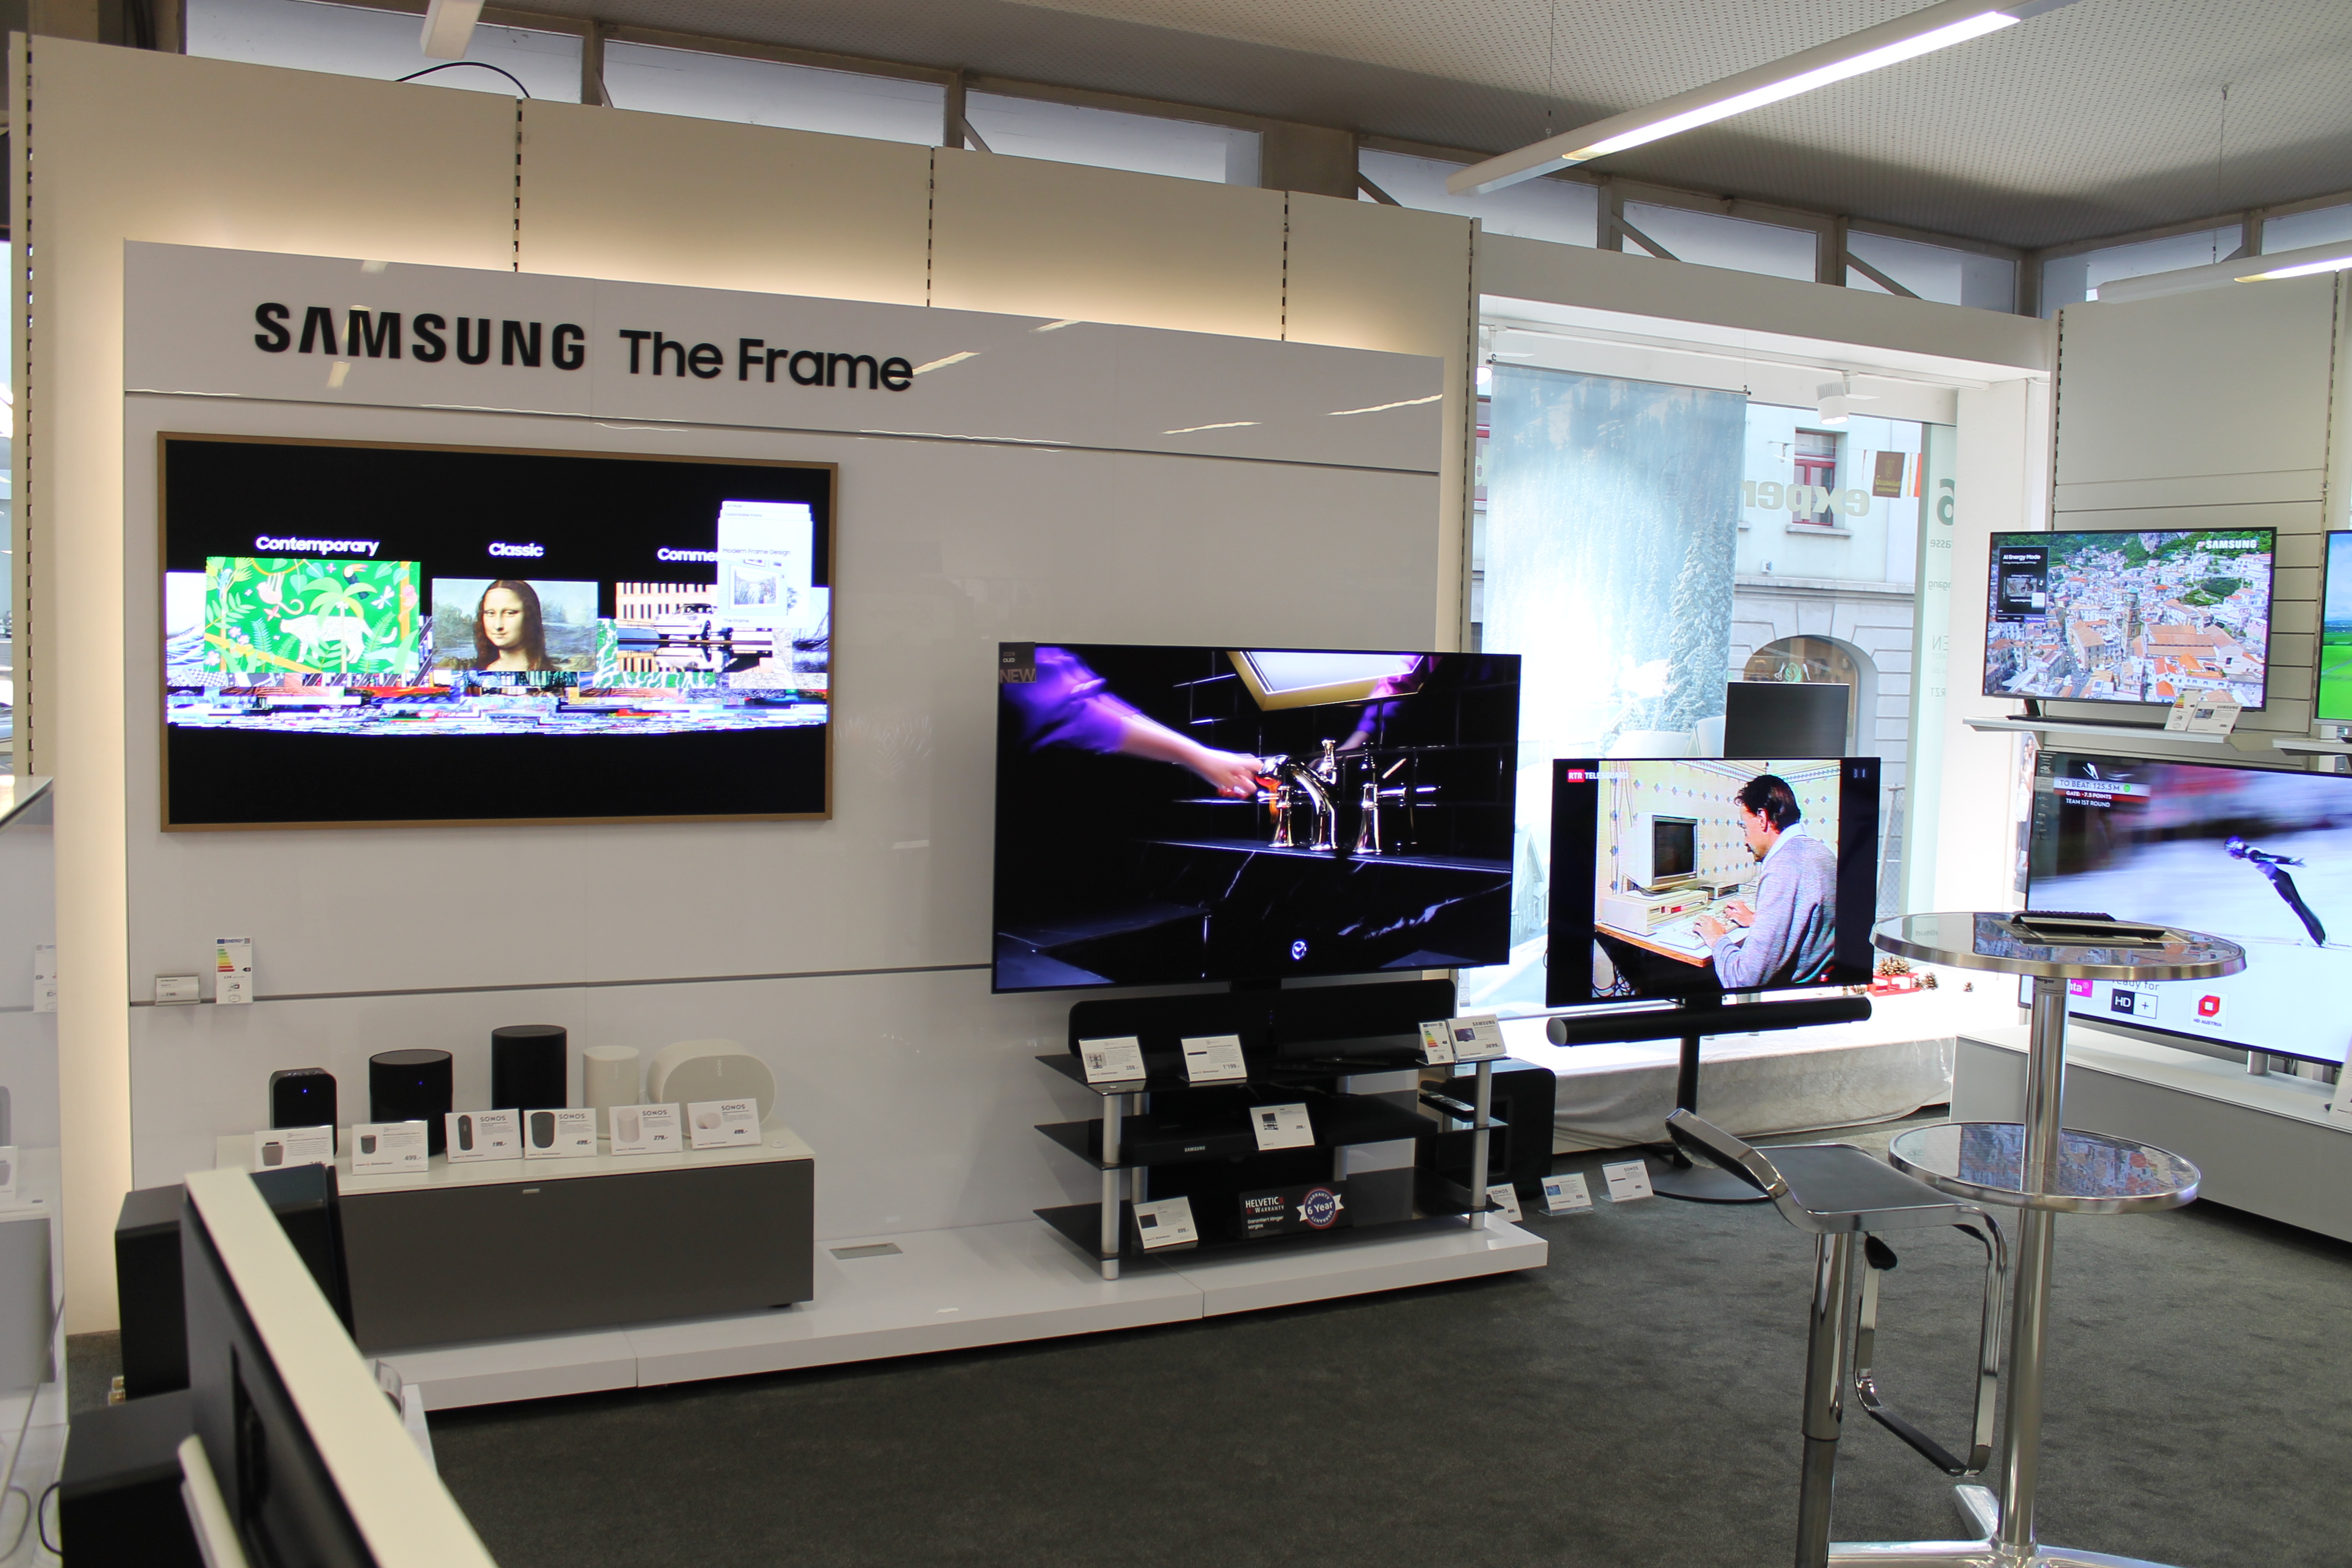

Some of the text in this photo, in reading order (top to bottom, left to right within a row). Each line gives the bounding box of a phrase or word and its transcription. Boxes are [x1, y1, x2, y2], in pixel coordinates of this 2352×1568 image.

[254, 302, 914, 392] SAMSUNG The Frame
[255, 536, 380, 557] Contemporary
[488, 543, 545, 557] Classic
[2206, 540, 2257, 549] SAMSUNG
[657, 548, 718, 562] Comme
[999, 668, 1036, 683] NEW
[1585, 771, 1629, 780] TELESGUARD
[2071, 781, 2092, 789] BEAT:
[2143, 982, 2160, 990] for
[2114, 995, 2131, 1008] HD
[1245, 1196, 1280, 1208] HELVETIC
[1307, 1192, 1330, 1205] WARRANTY
[1255, 1205, 1284, 1213] WARRANTY
[1307, 1201, 1333, 1215] 6 Year
[1311, 1210, 1333, 1223] WARRANTY
